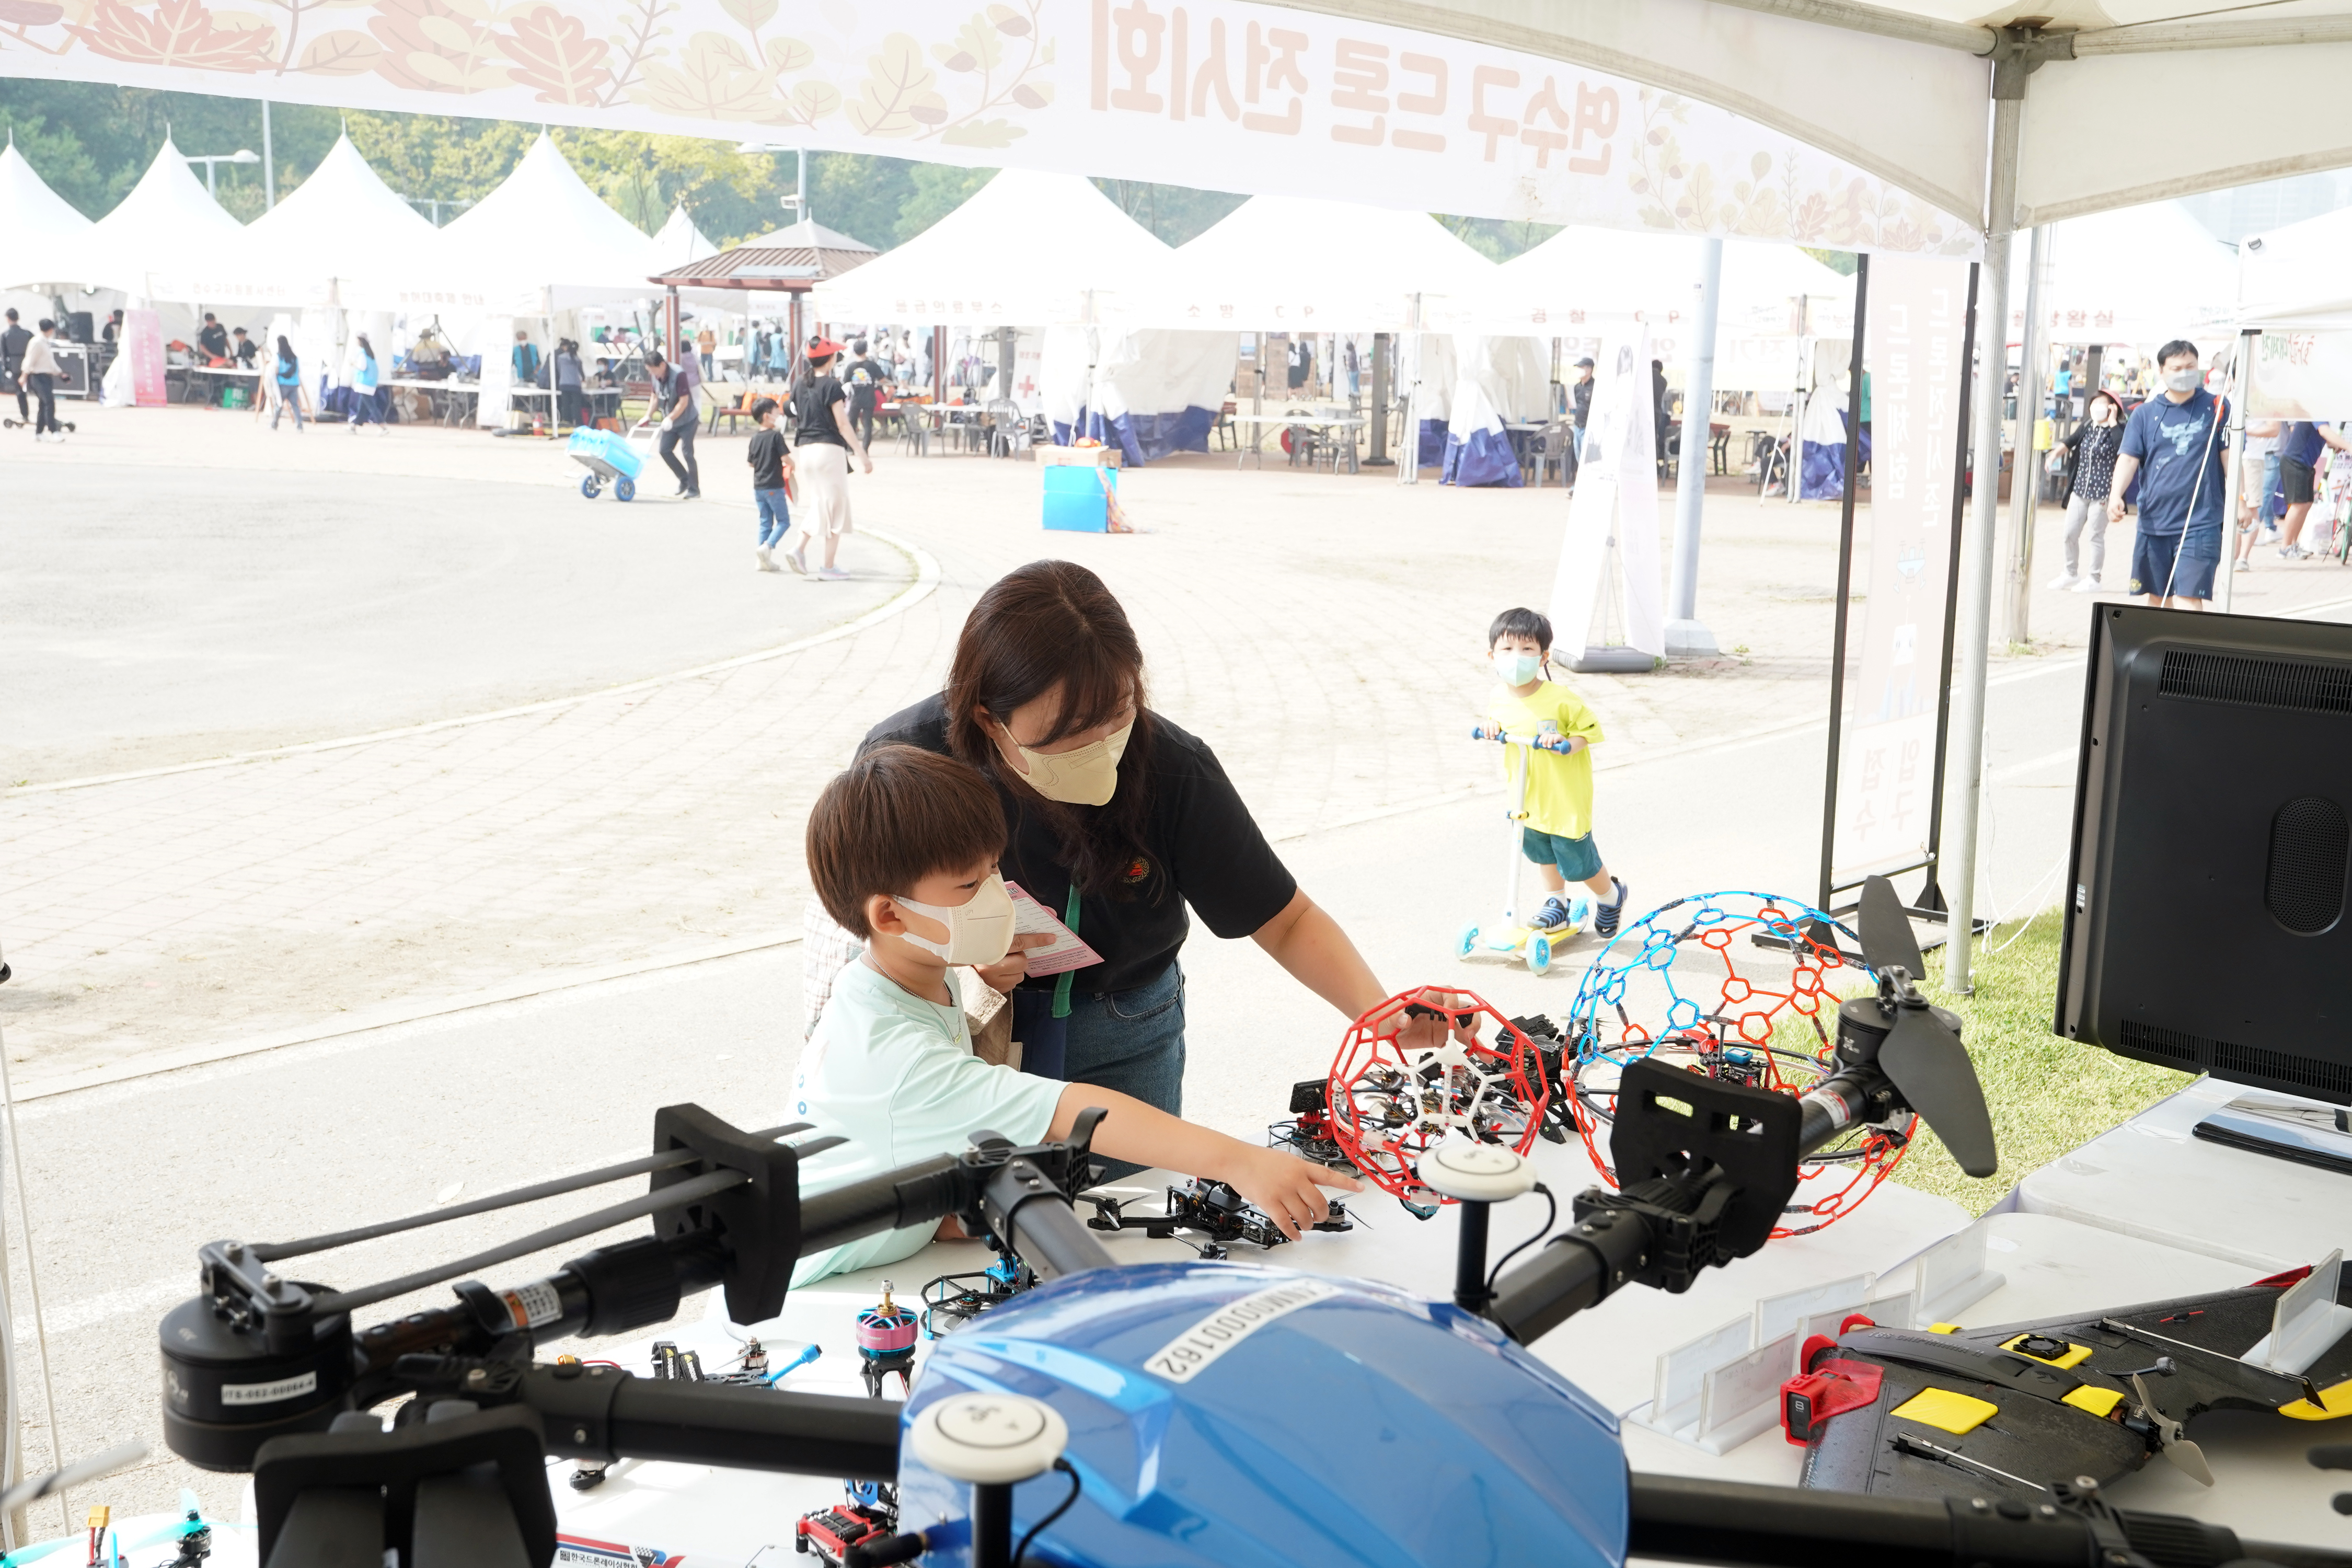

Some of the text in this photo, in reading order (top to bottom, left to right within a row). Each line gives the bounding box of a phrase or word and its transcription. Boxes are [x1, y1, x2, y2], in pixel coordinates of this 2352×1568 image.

[895, 298, 1003, 315] 응급의료부스
[1187, 303, 1235, 319] 소방
[1530, 307, 1587, 325] 경찰
[1795, 1400, 1805, 1411] 8
